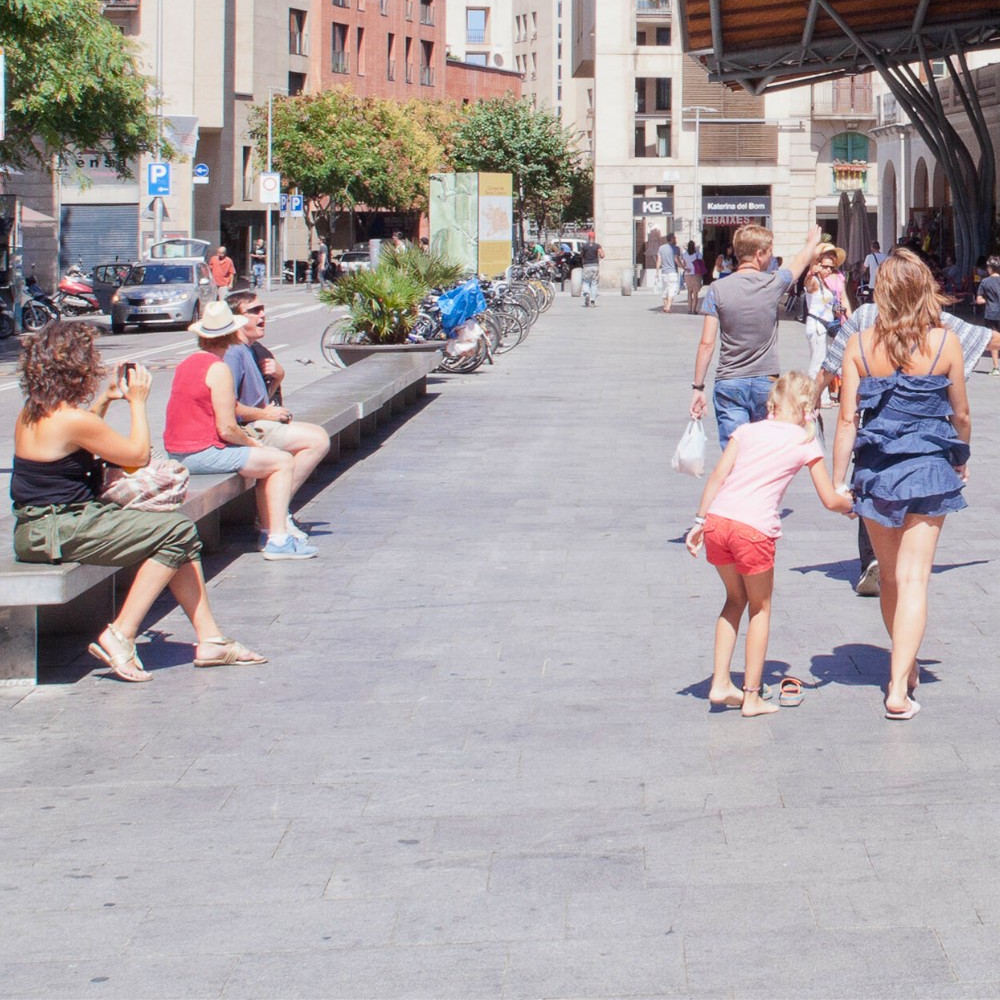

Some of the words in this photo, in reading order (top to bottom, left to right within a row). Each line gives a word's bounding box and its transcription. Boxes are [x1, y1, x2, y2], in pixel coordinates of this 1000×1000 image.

[151, 165, 166, 183] P
[292, 197, 301, 211] P
[642, 201, 663, 213] KB
[707, 202, 736, 210] Katerina
[736, 202, 747, 210] del
